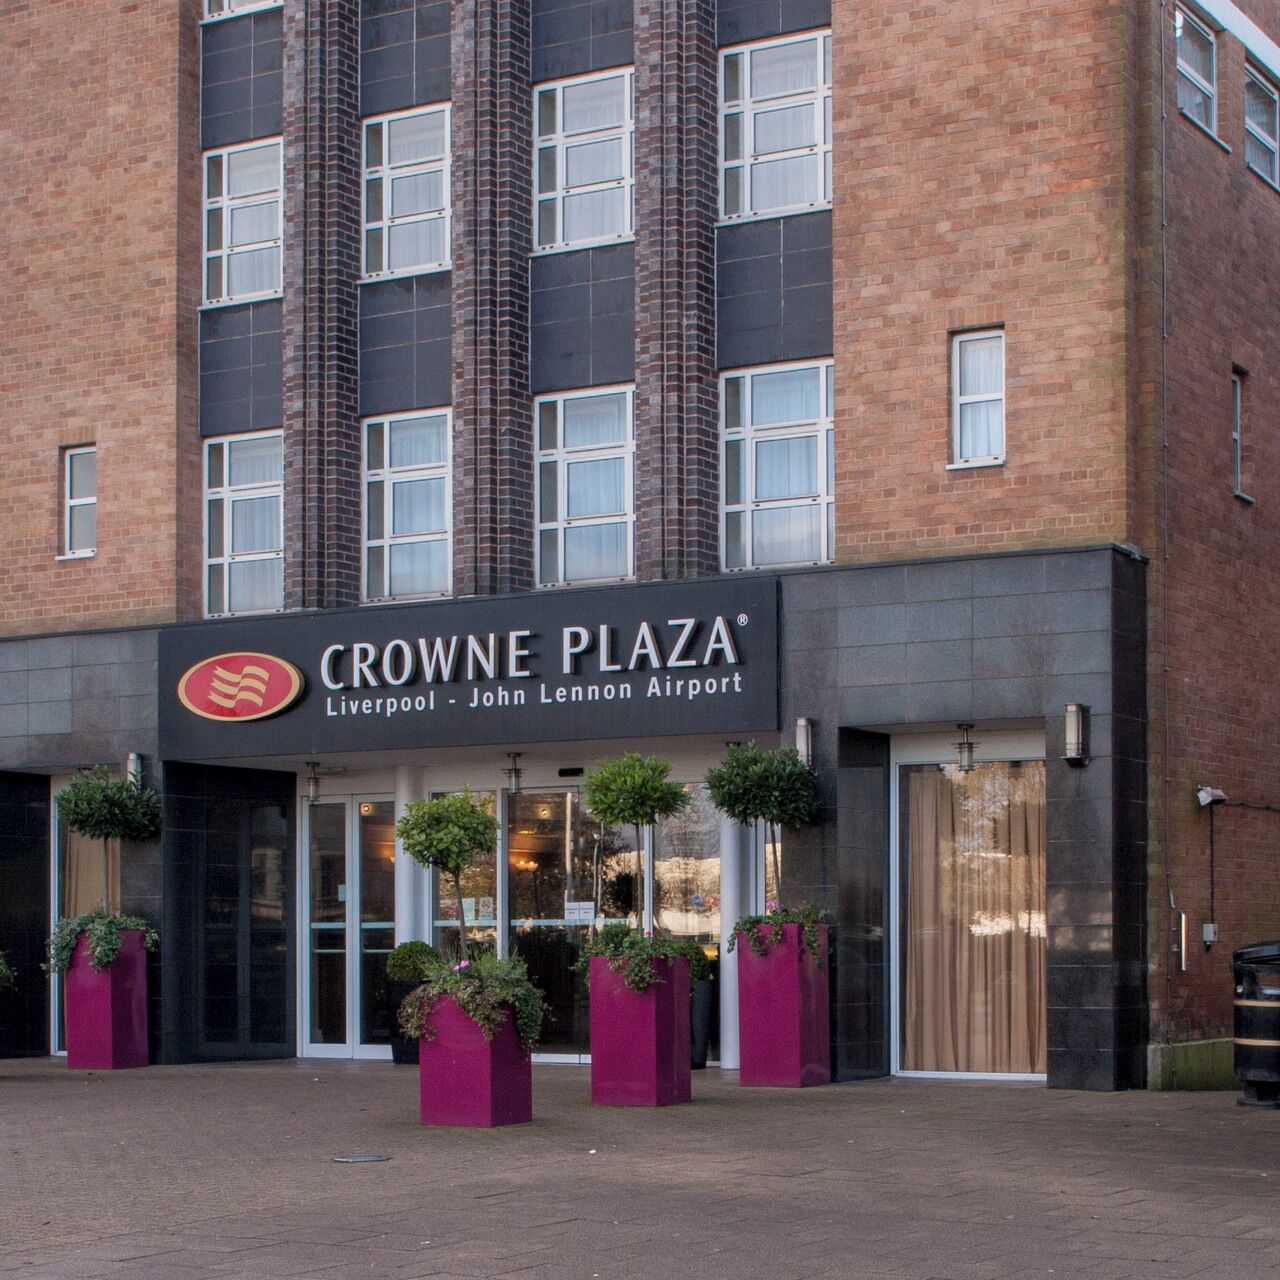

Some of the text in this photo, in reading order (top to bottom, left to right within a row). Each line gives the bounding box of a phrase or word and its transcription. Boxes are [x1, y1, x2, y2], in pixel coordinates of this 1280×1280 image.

[320, 630, 531, 690] CROWNE
[326, 690, 435, 718] Liverpool
[468, 685, 525, 708] John
[540, 682, 632, 704] Lennon
[646, 671, 742, 700] Airport
